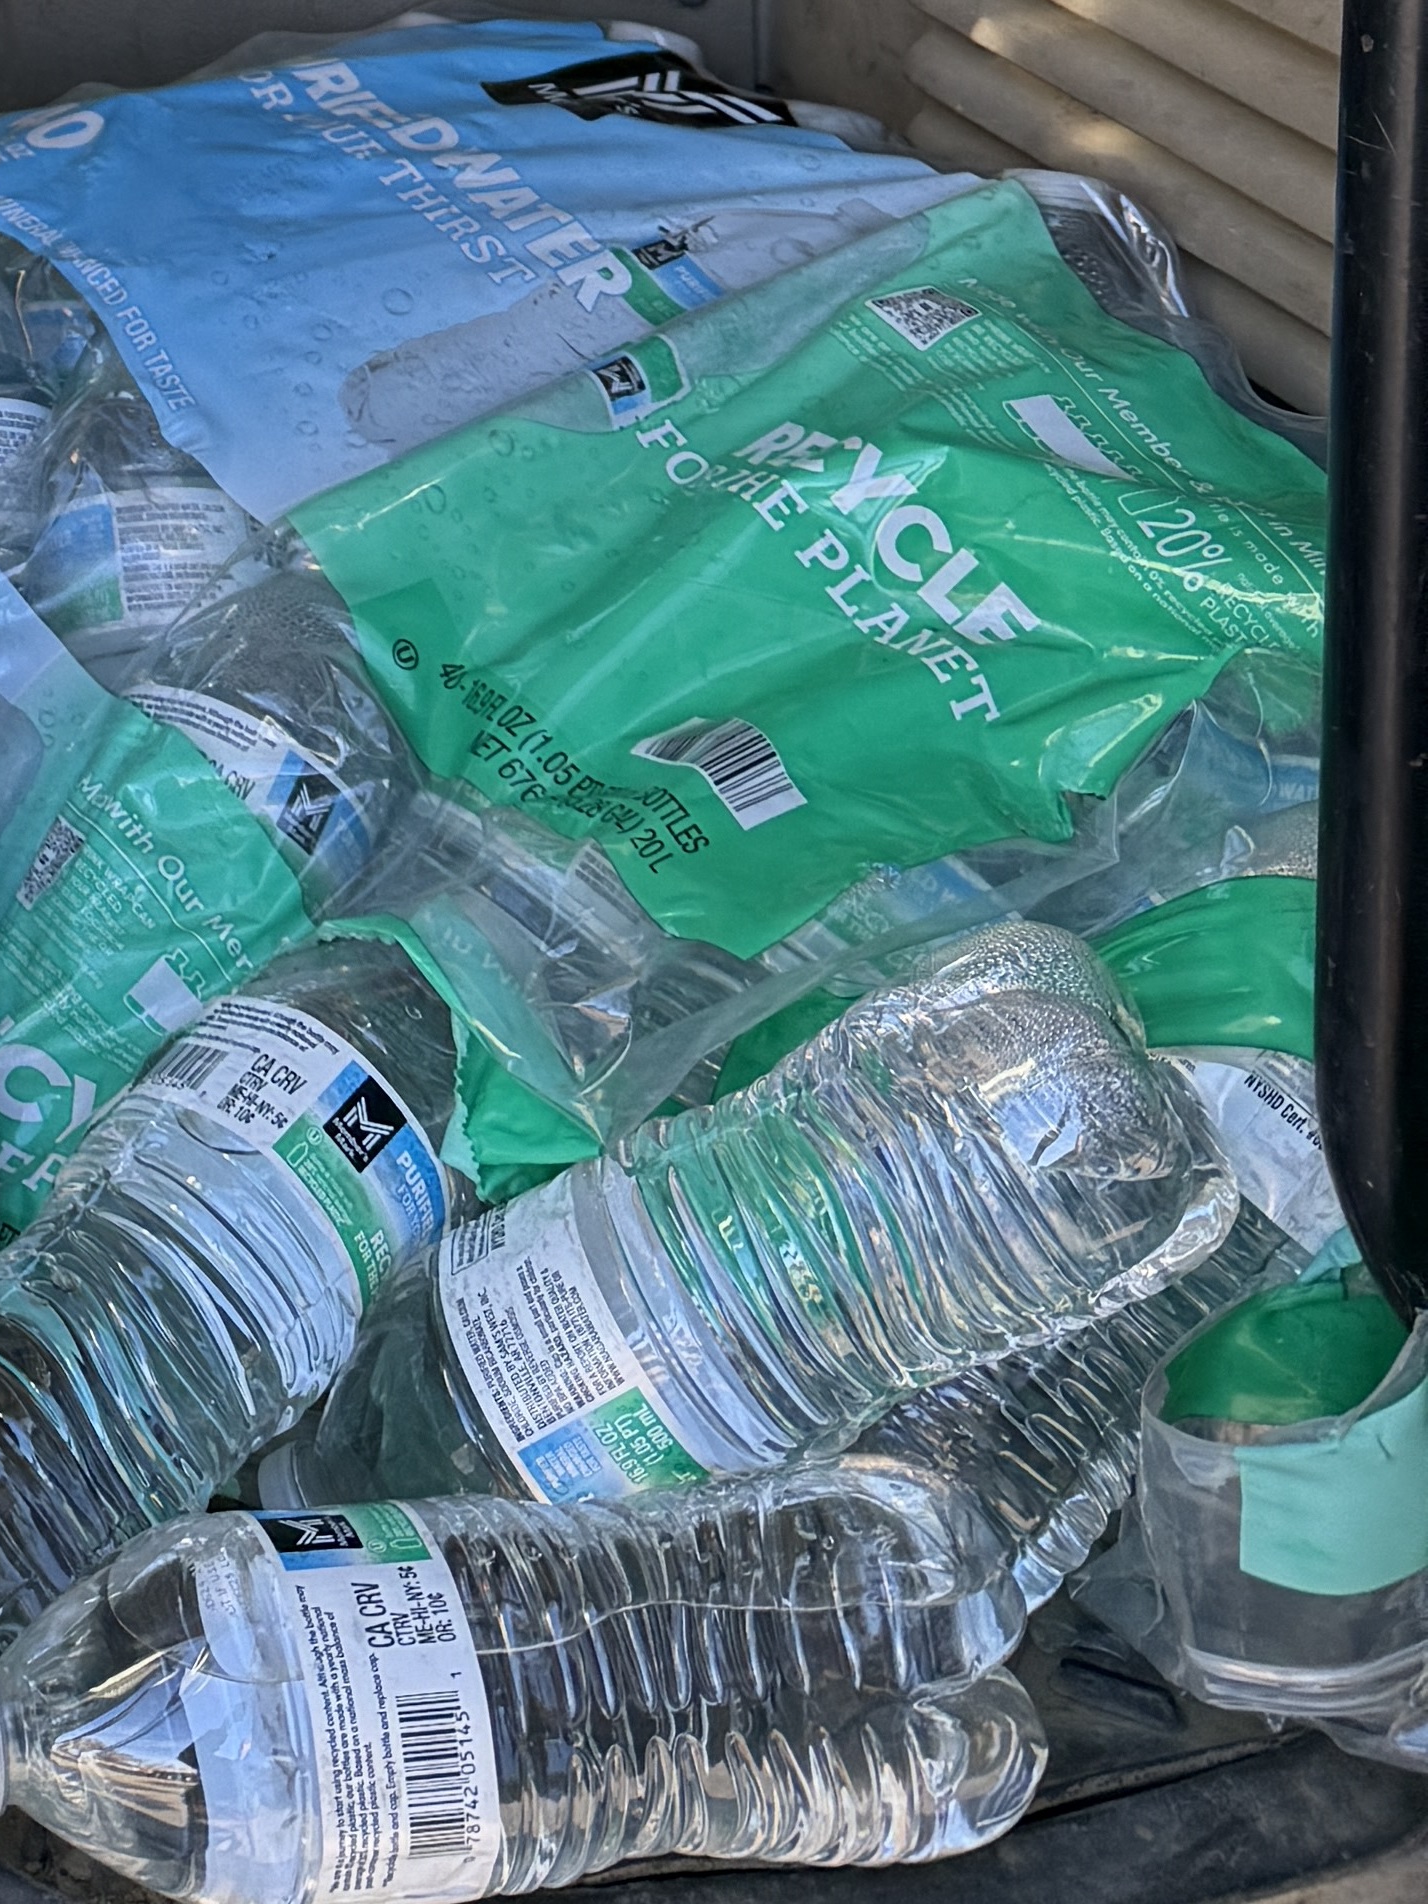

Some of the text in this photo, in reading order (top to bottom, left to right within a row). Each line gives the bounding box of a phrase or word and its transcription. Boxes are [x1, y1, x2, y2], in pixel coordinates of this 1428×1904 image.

[379, 157, 542, 286] THIRST
[116, 306, 158, 352] FOR
[145, 350, 196, 411] TASTE
[1099, 387, 1195, 476] Member
[733, 421, 1042, 646] REYCLE
[1137, 508, 1232, 592] 20%
[1245, 540, 1283, 583] made
[794, 528, 1001, 722] PLANET
[498, 706, 709, 854] OZ (1.05 OTTLES
[106, 799, 205, 914] with Our
[239, 1071, 268, 1093] CTRV
[251, 1053, 308, 1096] CA CRV
[1241, 1067, 1312, 1135] NYSHD Cert.
[396, 1184, 417, 1214] FOR
[490, 1329, 511, 1359] SAM'S
[498, 1318, 516, 1348] 72716
[509, 1371, 547, 1429] DISTRIBUTED
[553, 1385, 567, 1402] BPA
[592, 1419, 649, 1485] 16.9 FL OZ
[612, 1409, 665, 1469] (1.05 PT)
[630, 1401, 674, 1452] 500 mL
[351, 1579, 396, 1648] CA CRV
[390, 1611, 416, 1646] CTRV
[400, 1564, 438, 1644] ME-HI-NY: 5¢
[426, 1590, 457, 1641] OR: 10¢
[328, 1621, 345, 1657] balance
[334, 1703, 346, 1730] made
[342, 1685, 357, 1723] national
[318, 1688, 344, 1816] start using recycled content.
[340, 1750, 352, 1781] bottles
[352, 1748, 363, 1776] Based
[371, 1673, 399, 1829] and cap. Empty bottle and replace
[454, 1710, 475, 1774] 05145
[362, 1741, 380, 1847] recycled content.
[462, 1785, 482, 1845] 78742
[360, 1812, 369, 1848] recycled
